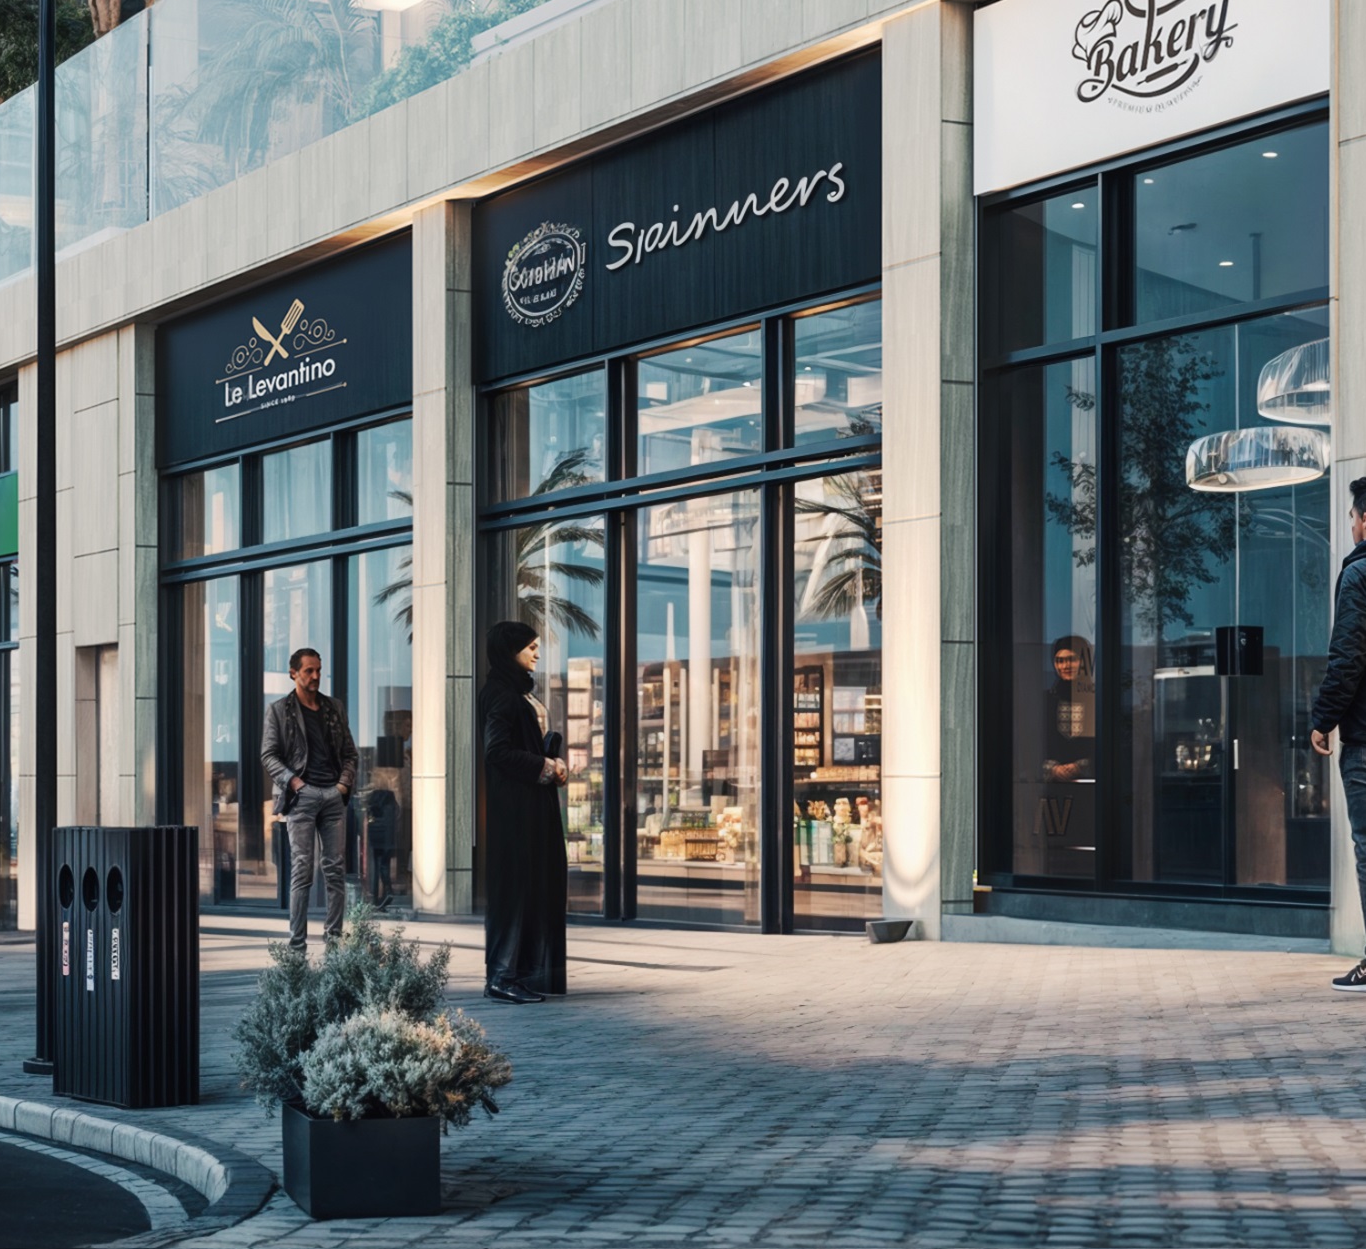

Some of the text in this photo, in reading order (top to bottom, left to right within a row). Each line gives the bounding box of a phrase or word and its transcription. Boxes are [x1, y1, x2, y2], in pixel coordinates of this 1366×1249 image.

[606, 162, 846, 270] Spinners
[225, 356, 336, 407] Le Levantino
